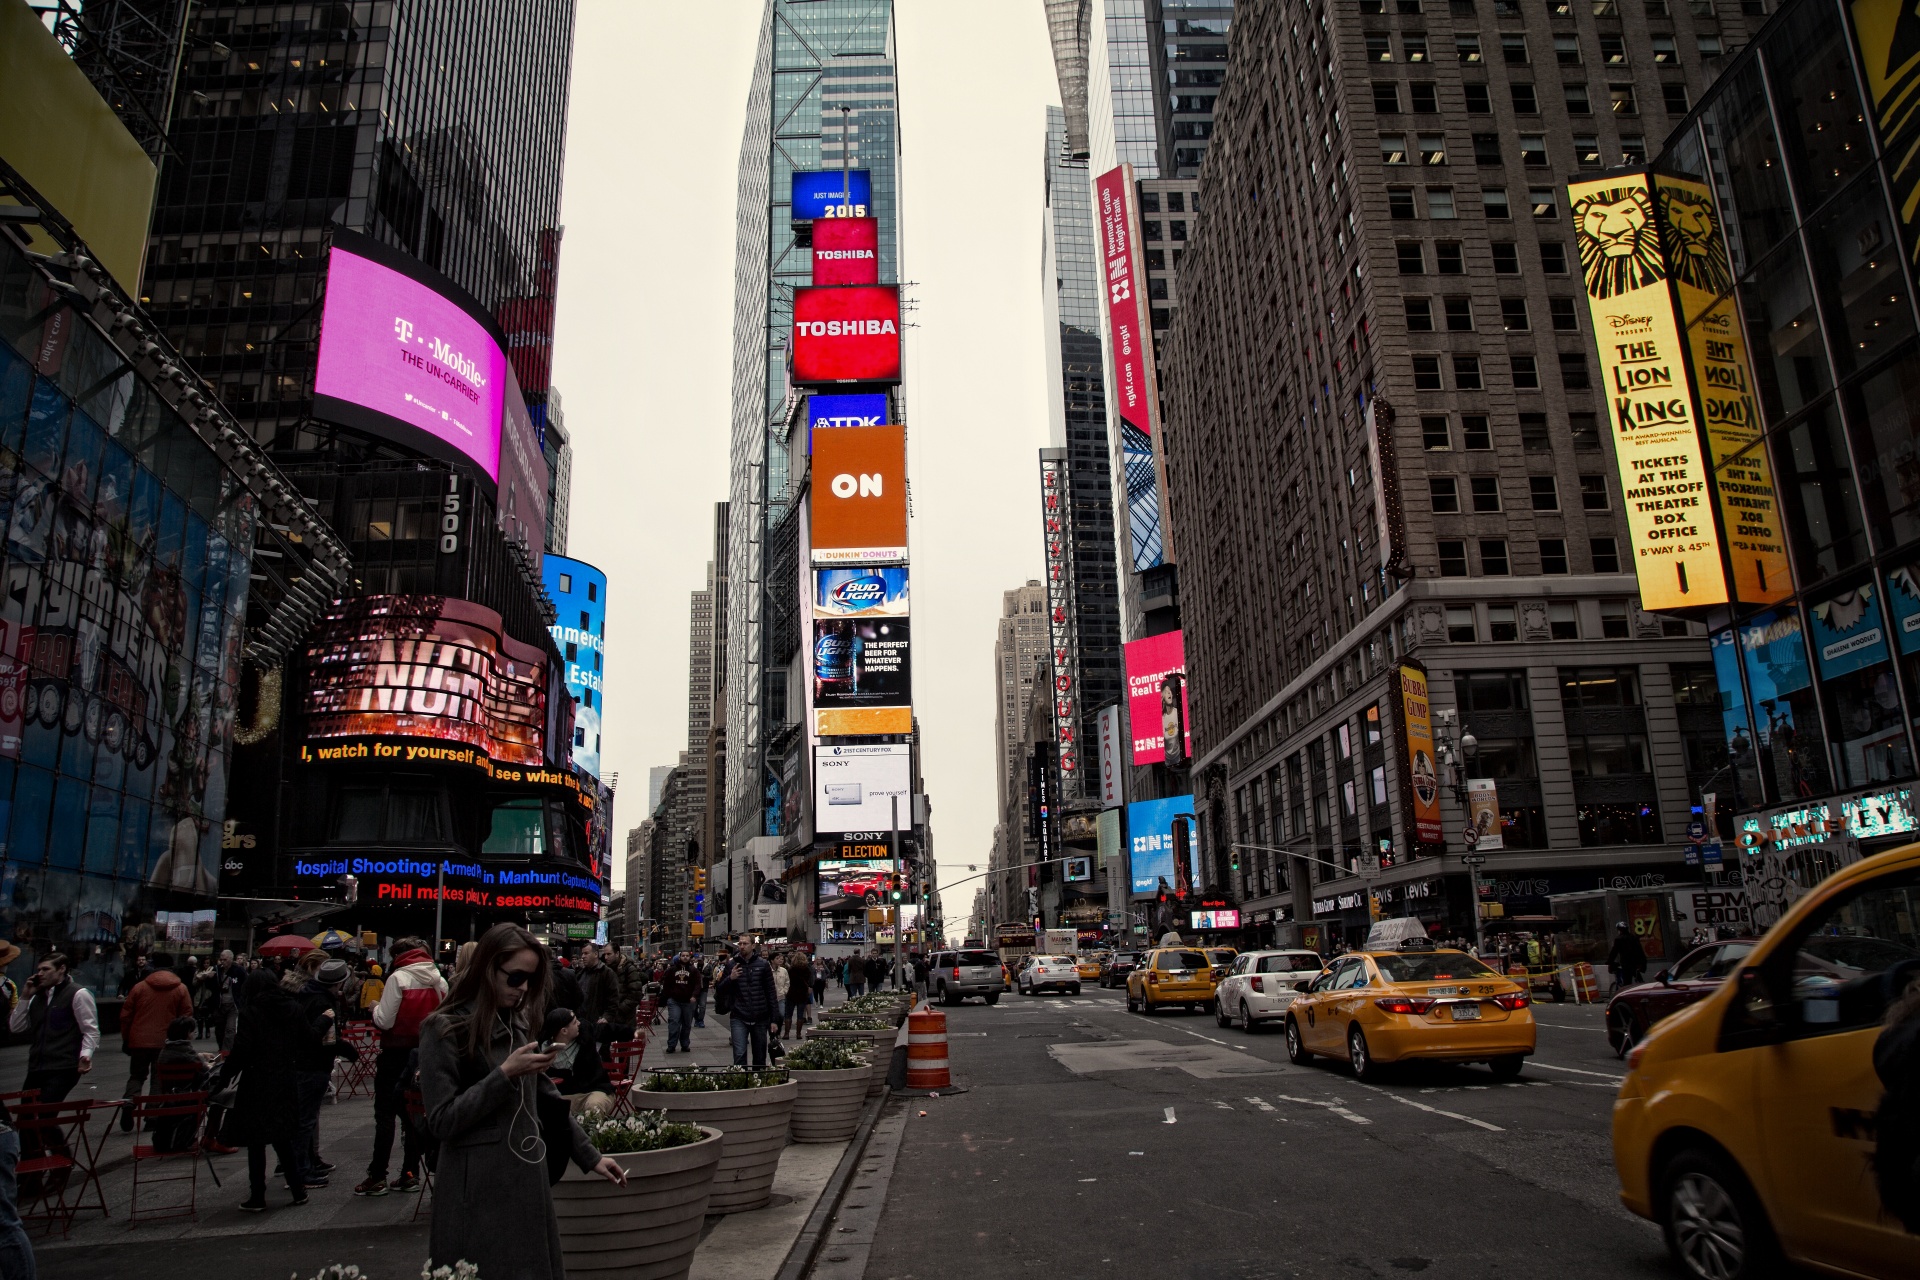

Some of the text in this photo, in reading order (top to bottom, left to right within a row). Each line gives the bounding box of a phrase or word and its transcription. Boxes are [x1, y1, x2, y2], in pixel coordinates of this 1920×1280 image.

[813, 191, 852, 199] JUST IMAGIE
[824, 204, 866, 218] 2015
[1102, 188, 1116, 258] Newmark Grubb
[1112, 196, 1126, 256] Knight Frank
[816, 249, 874, 260] TOSHIBA
[796, 319, 897, 337] TOSHIBA
[1605, 313, 1653, 328] Disney
[1616, 327, 1653, 336] PRESENTS
[1122, 324, 1132, 356] @ngkf
[1616, 340, 1657, 360] THE
[401, 349, 424, 370] THE
[1122, 362, 1137, 408] ngkf.com
[1612, 365, 1671, 395] LION
[1614, 396, 1687, 433] KING
[1631, 455, 1689, 470] TICKETS
[1638, 469, 1688, 484] AT THE
[831, 473, 883, 498] ON
[1627, 481, 1704, 499] MINSKOFF
[1636, 497, 1699, 512] THEATRE
[440, 474, 460, 554] 1500
[1653, 512, 1687, 525] BOX
[1647, 526, 1698, 540] OFFICE
[863, 550, 898, 558] DONUTS
[1640, 545, 1674, 556] B'WAY
[1677, 543, 1686, 553] &
[845, 582, 880, 592] BUD
[839, 591, 885, 600] LIGHT
[1046, 473, 1061, 580] ERNST
[1056, 648, 1075, 772] YOUNG
[864, 641, 909, 649] THE PERFECT
[1826, 633, 1876, 656] SHAILENE WOODLEY
[883, 649, 897, 657] FOR
[864, 657, 902, 665] WHATEVER
[864, 665, 899, 673] HAPPENS.
[1131, 685, 1153, 697] Real
[1402, 673, 1427, 698] BUBBA
[1406, 697, 1427, 719] GUMP
[318, 742, 368, 759] watch
[373, 742, 401, 757] for
[406, 745, 474, 764] yourself
[1102, 714, 1113, 801] RICOH
[496, 768, 521, 781] see
[526, 769, 562, 785] what
[222, 833, 257, 849] ars
[843, 832, 885, 841] SONY
[842, 845, 887, 858] ELECTION
[224, 860, 243, 870] abc
[352, 857, 437, 878] Shooting:
[442, 859, 476, 877] Armed
[483, 869, 494, 884] in
[500, 869, 561, 885] Manhunt
[378, 883, 413, 898] Phil
[417, 885, 464, 900] makes
[575, 895, 592, 911] holders
[1692, 892, 1747, 908] EDM
[1633, 915, 1658, 936] 87
[1304, 935, 1318, 946] 87
[1478, 985, 1495, 995] 235
